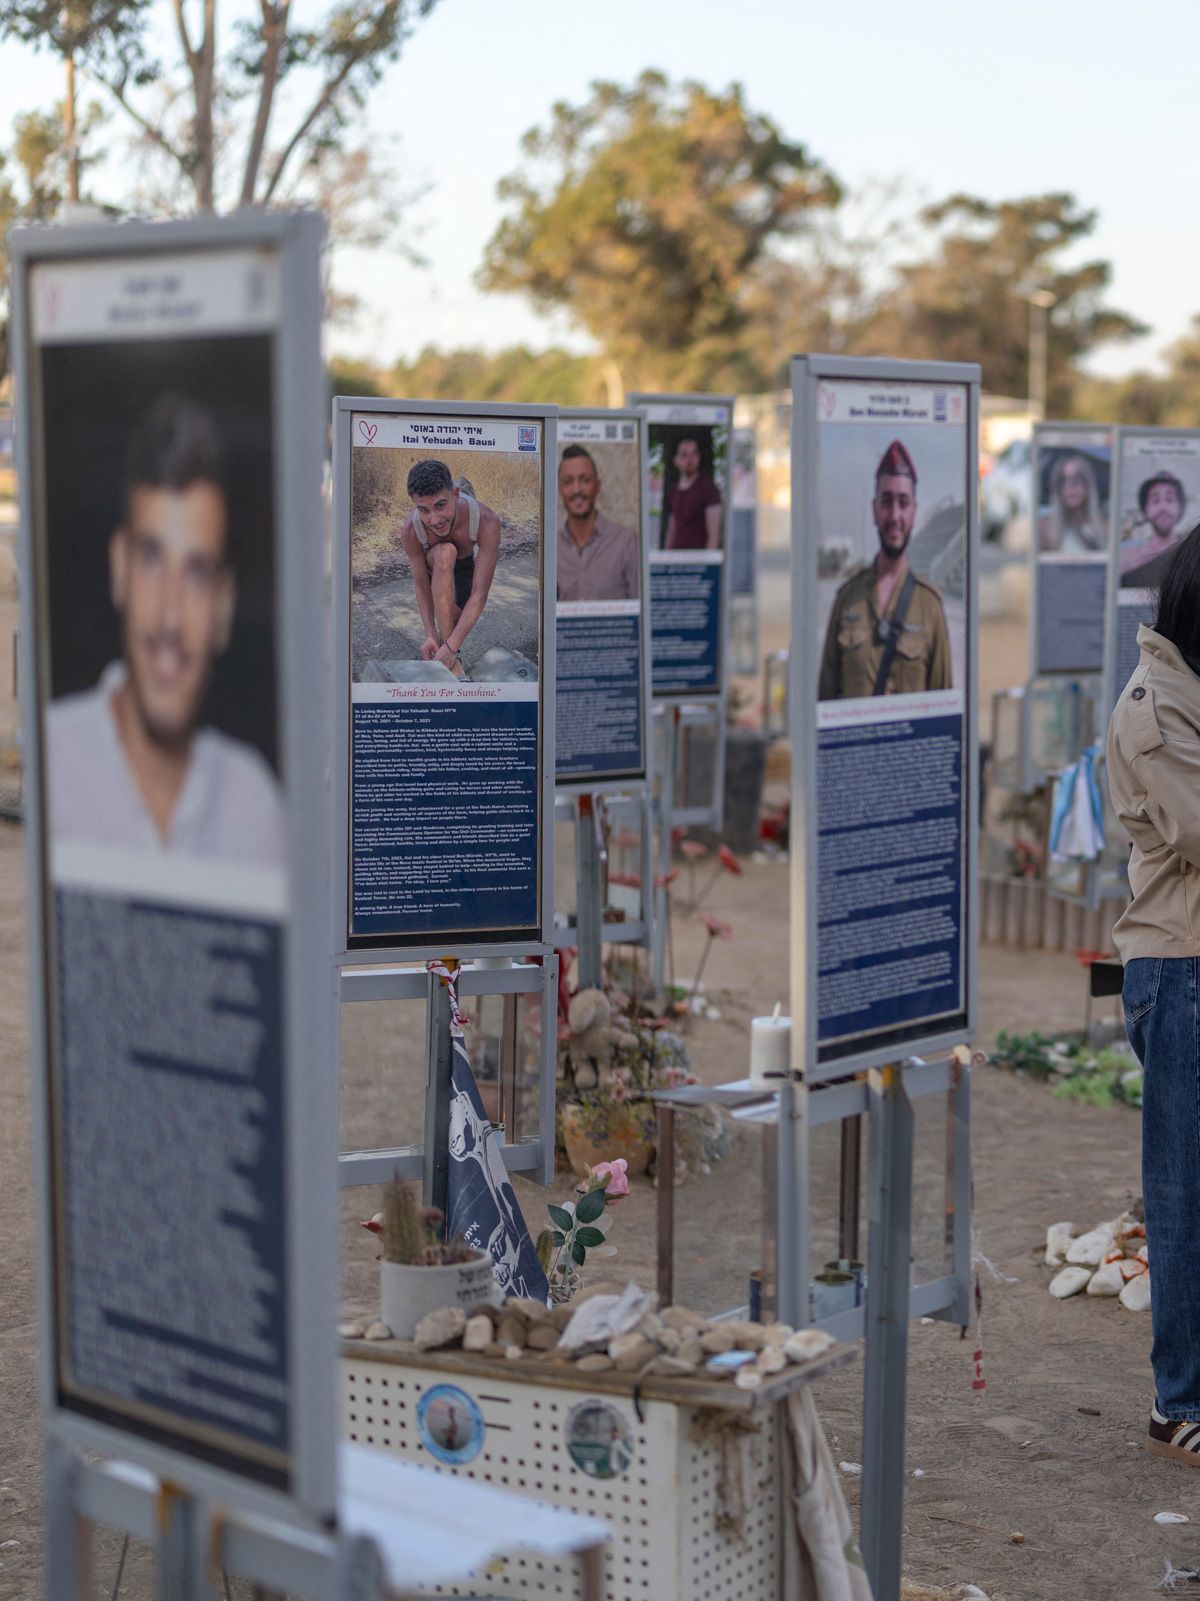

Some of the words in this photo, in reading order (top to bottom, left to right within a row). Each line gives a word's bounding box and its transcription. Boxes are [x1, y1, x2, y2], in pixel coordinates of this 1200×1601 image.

[410, 424, 435, 433] באוסי
[422, 436, 463, 444] Yehudah
[469, 438, 496, 446] Bausi
[421, 688, 436, 697] You
[439, 688, 455, 697] For
[464, 1221, 480, 1240] איתי
